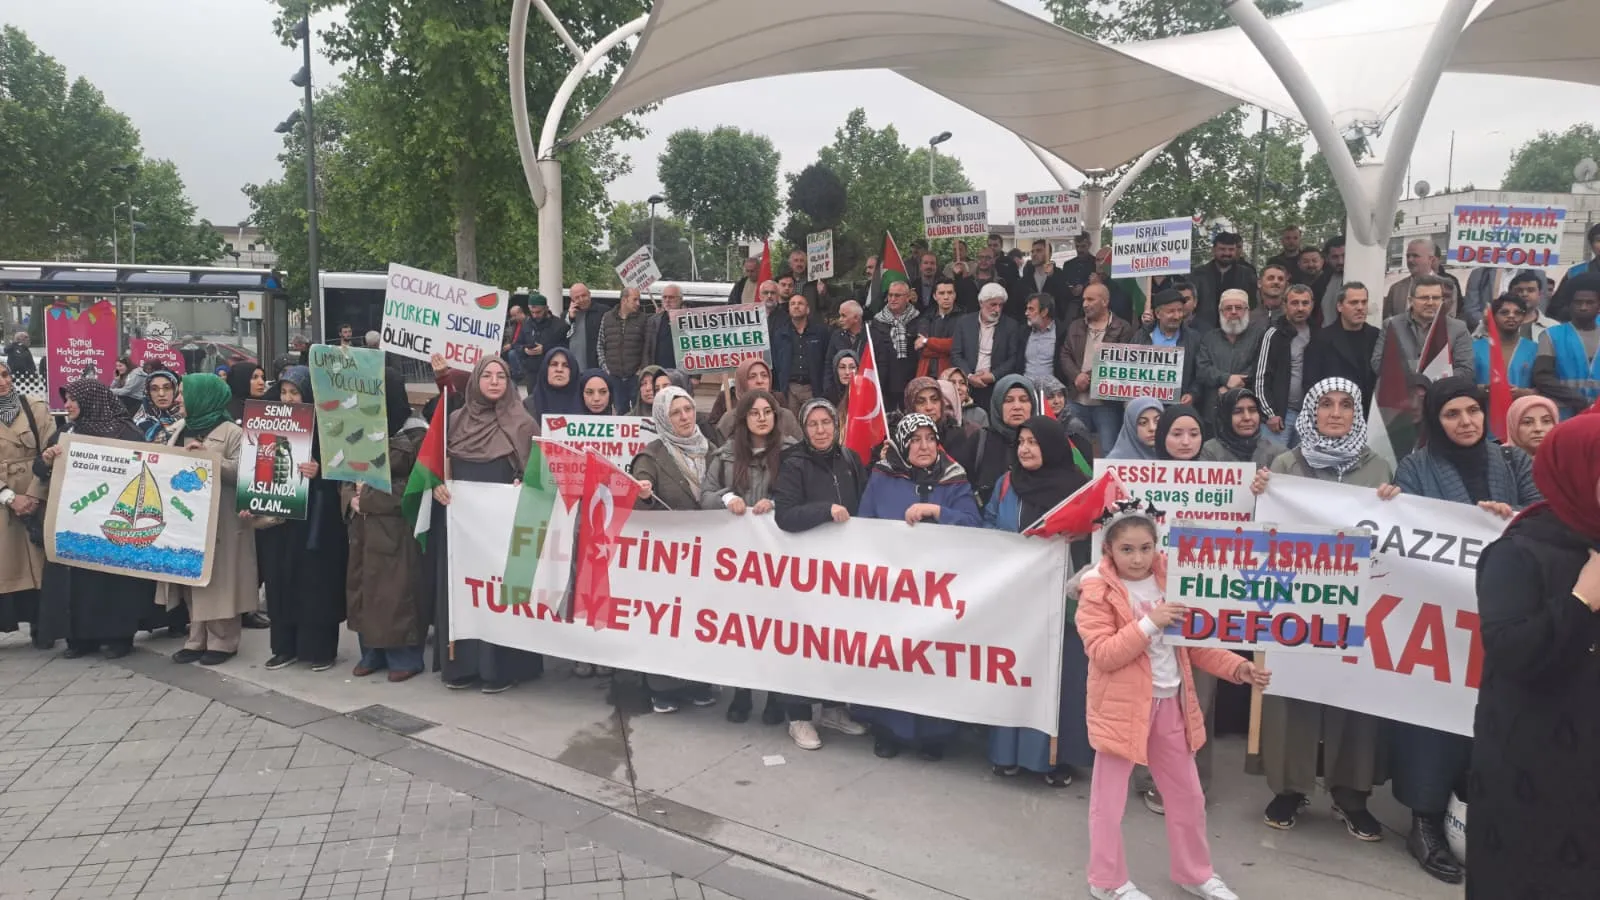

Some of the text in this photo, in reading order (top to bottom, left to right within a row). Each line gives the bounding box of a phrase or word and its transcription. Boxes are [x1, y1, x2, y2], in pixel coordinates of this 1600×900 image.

[1016, 204, 1080, 217] SOYKIRIM VAR
[1458, 205, 1558, 229] KATİL İSRAİL
[1019, 218, 1050, 227] GENOCIDE
[1135, 223, 1168, 239] İSRAİL
[1457, 229, 1557, 245] FİLİSTİN'DEN
[1114, 239, 1188, 256] İNSANLIK SUÇU
[1457, 246, 1551, 266] DEFOL!
[1131, 256, 1169, 272] İŞLİYOR
[385, 299, 500, 341] UYURKEN SUSULUR
[678, 307, 761, 330] FİLİSTİNLİ
[383, 323, 432, 354] ÖLÜNCE
[680, 331, 764, 350] BEBEKLER
[314, 351, 358, 370] UMUDA
[1100, 346, 1179, 365] FİLİSTİNLİ
[326, 370, 384, 395] YOLCULUK
[1098, 366, 1177, 382] BEBEKLER
[1098, 380, 1174, 400] ÖLMESİN!
[264, 404, 293, 417] SENİN
[567, 422, 640, 438] GAZZE'DE
[70, 450, 131, 465] UMUDA YELKEN
[72, 460, 127, 475] ÖZGÜR GAZZE
[1174, 467, 1242, 485] KALMA!
[247, 481, 297, 498] ASLINDA
[1145, 489, 1190, 507] savaş
[1195, 488, 1233, 507] değil
[250, 498, 291, 514] OLAN...
[1177, 526, 1359, 576] KATİL İSRAİL
[714, 547, 966, 620] SAVUNMAK,
[1180, 573, 1359, 605] FİLİSTİN'DEN
[1181, 606, 1351, 649] DEFOL!
[694, 608, 1032, 687] SAVUNMAKTIR.
